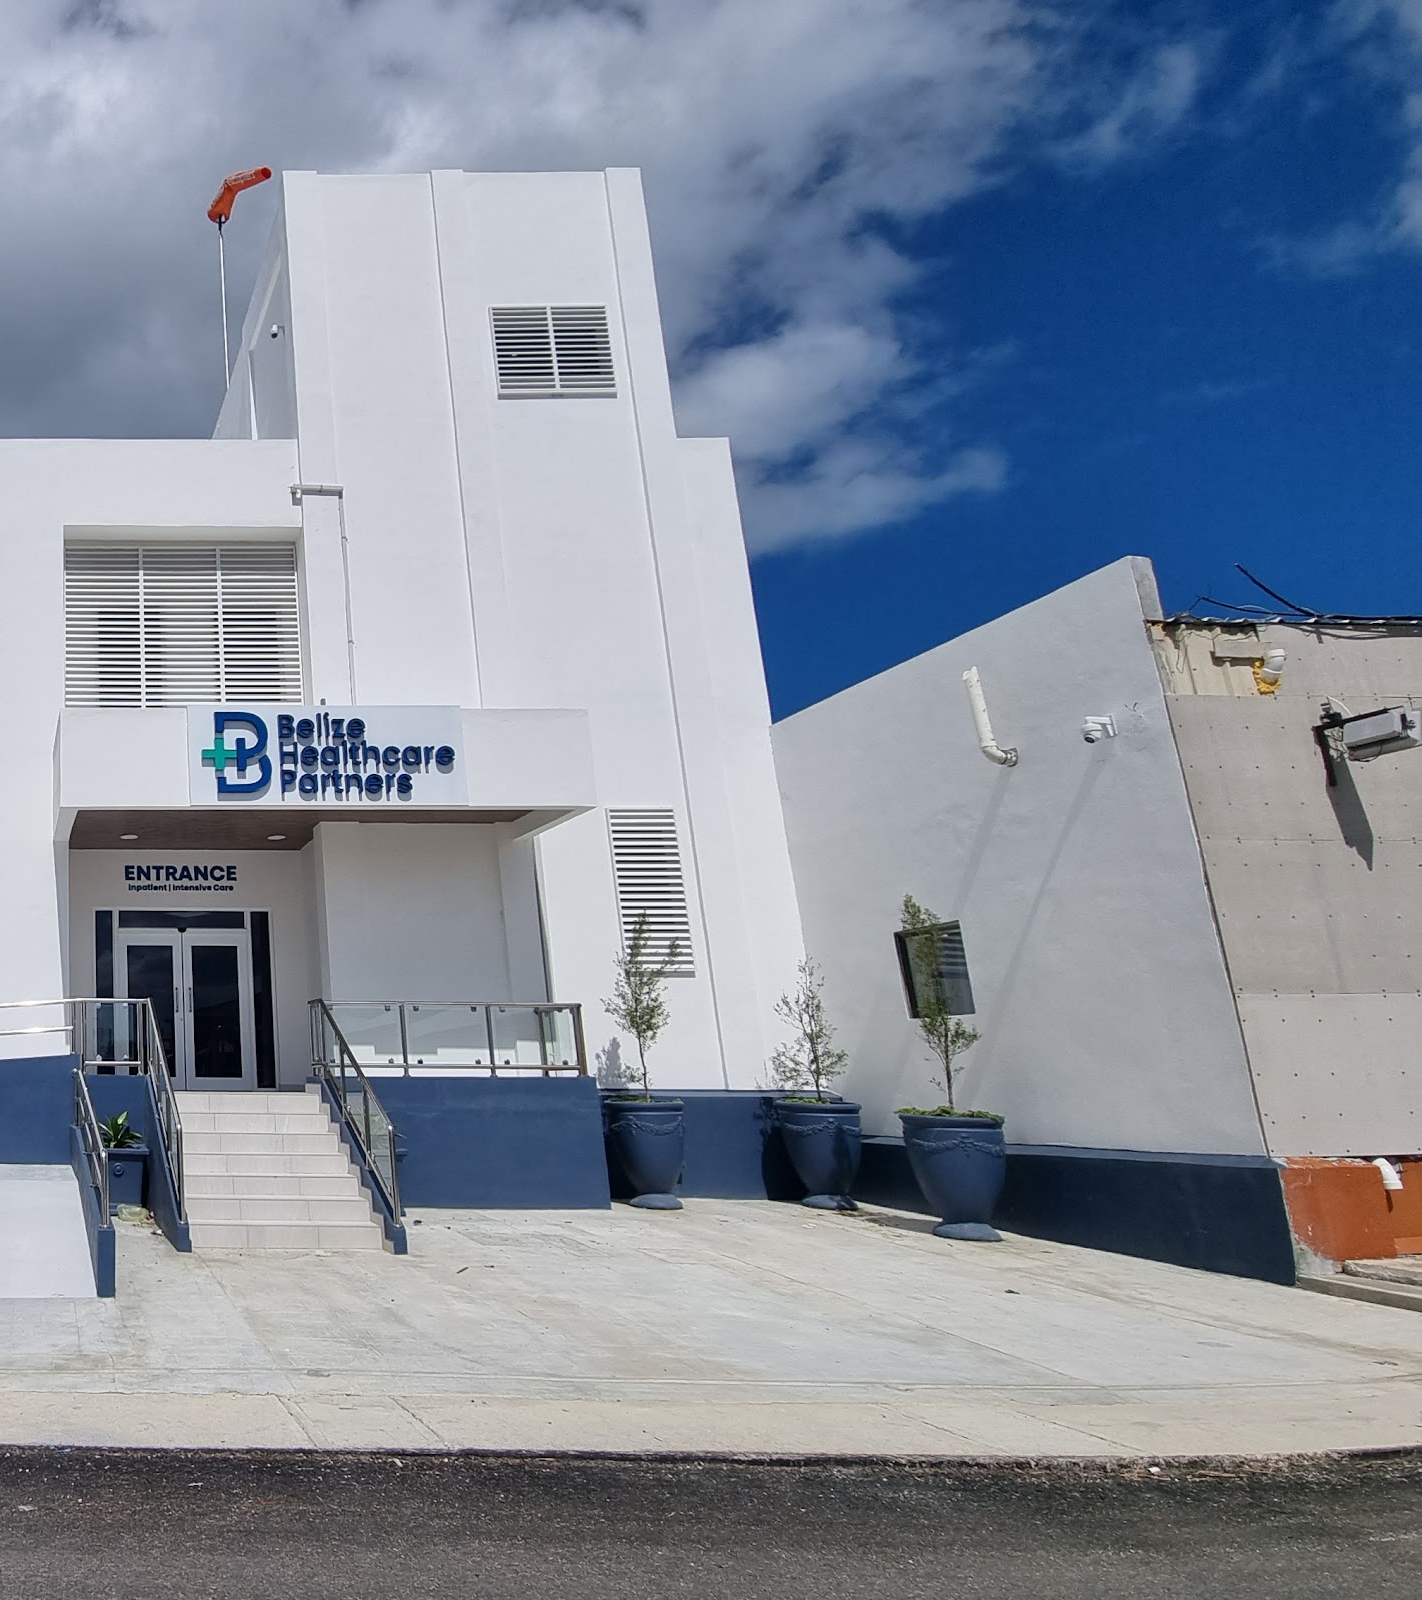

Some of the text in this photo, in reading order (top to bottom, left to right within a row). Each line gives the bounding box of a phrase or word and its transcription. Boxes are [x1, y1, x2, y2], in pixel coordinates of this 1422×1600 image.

[278, 712, 366, 739] Belize
[279, 740, 456, 767] Healthcare
[280, 769, 414, 794] Partners
[124, 865, 237, 881] ENTRANCE
[128, 883, 167, 892] Inpatient
[172, 883, 212, 891] Intensive
